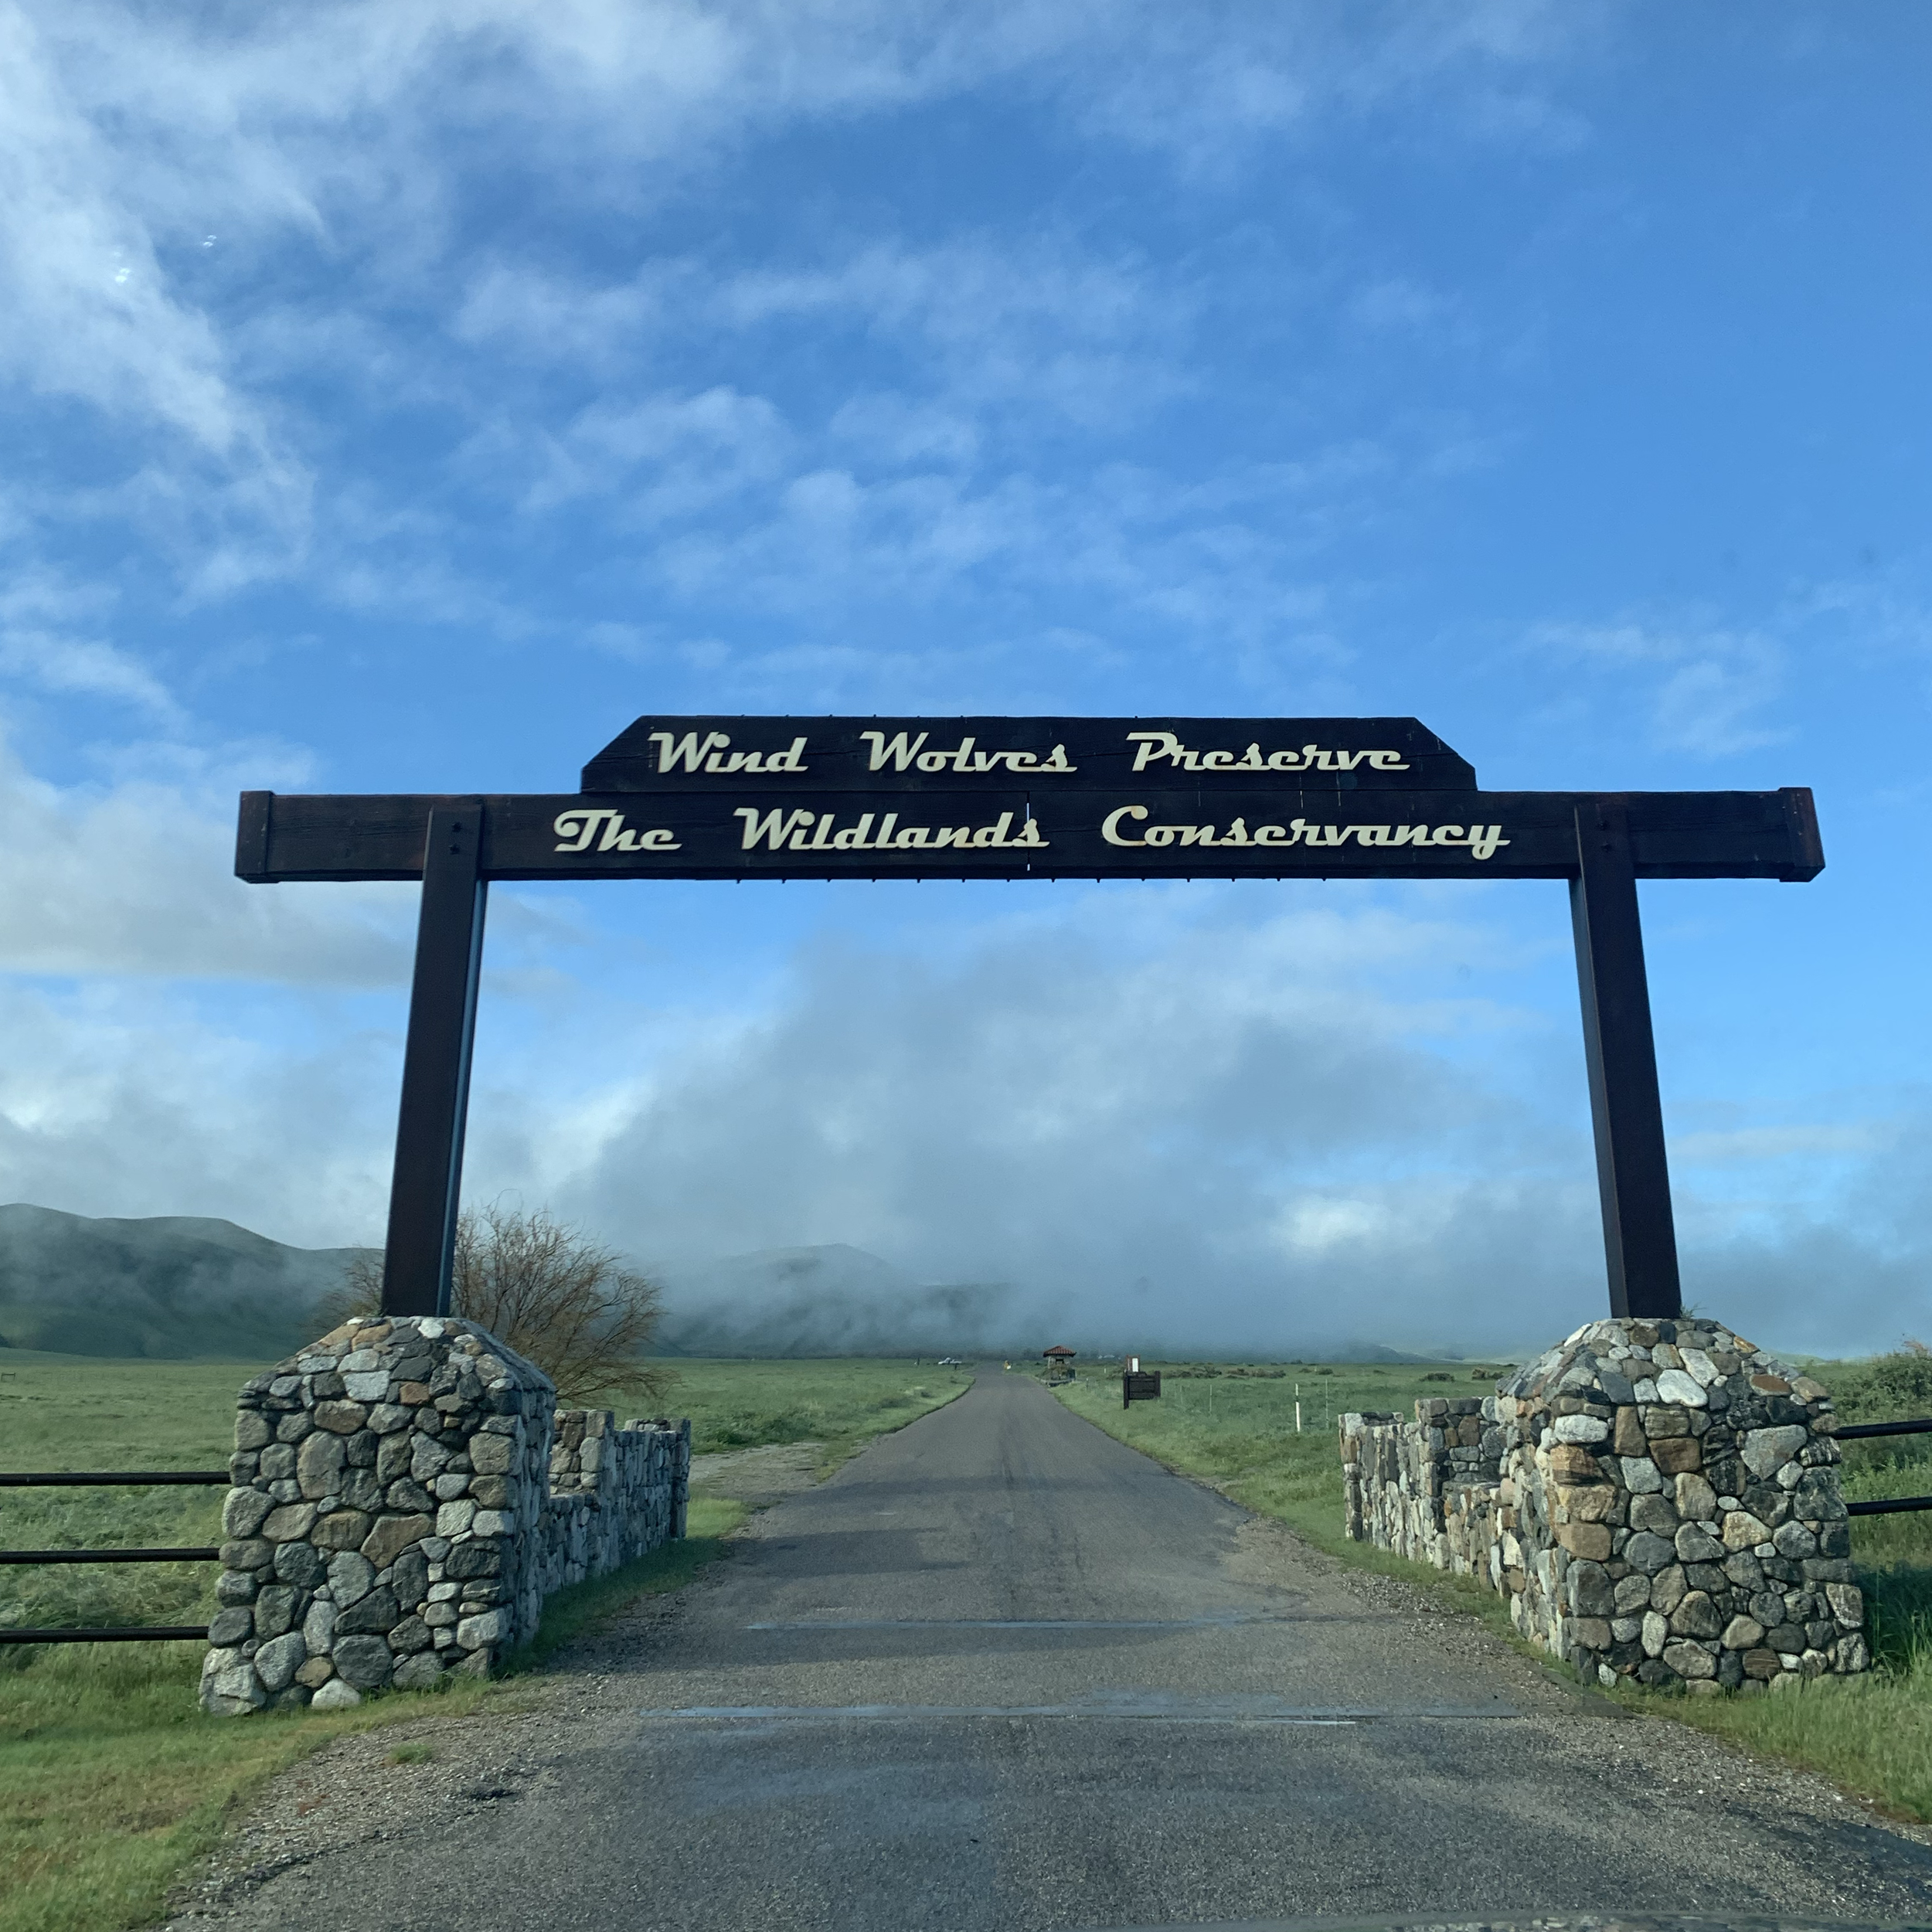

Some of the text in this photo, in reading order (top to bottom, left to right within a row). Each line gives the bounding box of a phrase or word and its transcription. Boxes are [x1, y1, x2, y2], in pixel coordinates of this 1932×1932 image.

[648, 730, 1410, 774] Wind Wolves Preserve
[553, 805, 1511, 860] The Wildlands Conservancy
